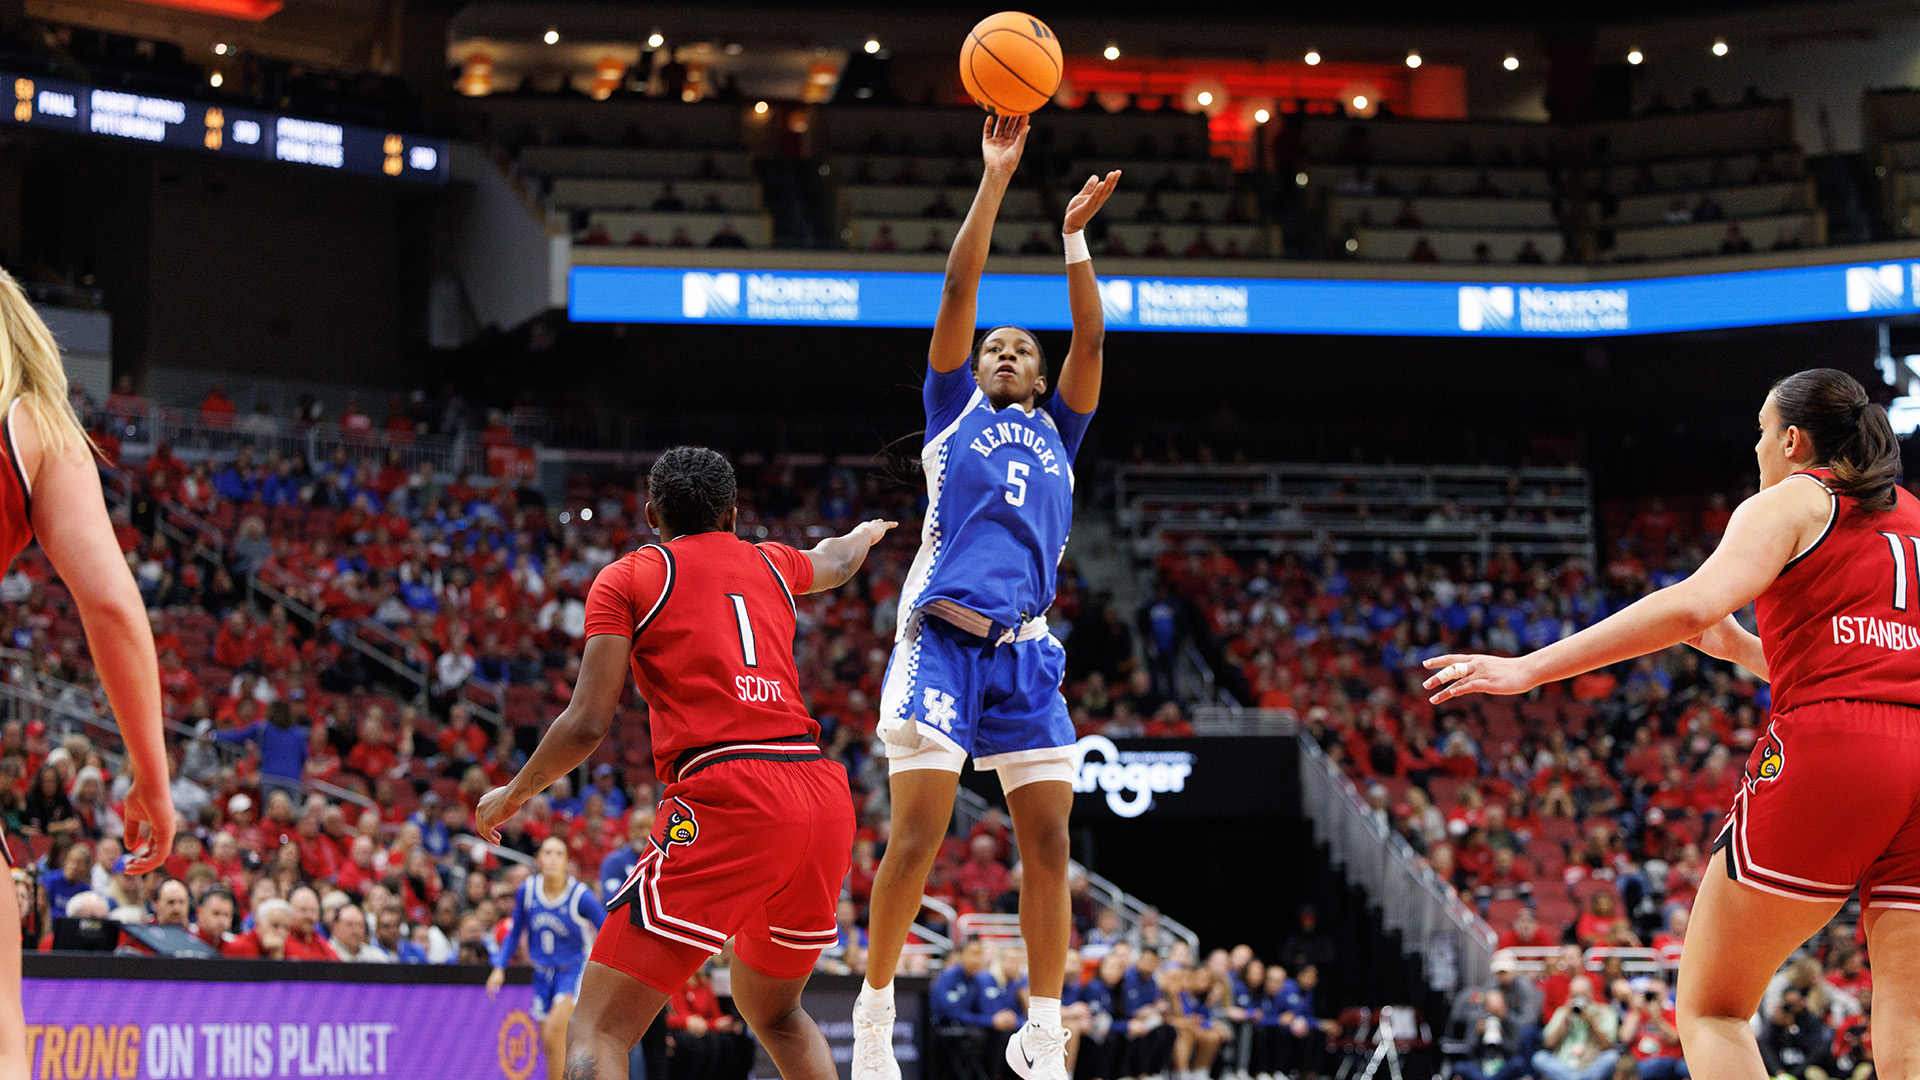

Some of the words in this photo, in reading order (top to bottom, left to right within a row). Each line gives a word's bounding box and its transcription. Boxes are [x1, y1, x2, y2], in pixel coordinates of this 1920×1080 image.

[970, 422, 1060, 477] KENTUCKY
[1005, 460, 1030, 507] 5
[724, 593, 758, 668] 1
[735, 675, 786, 702] SCOTT
[25, 1023, 141, 1080] TRONG
[146, 1023, 194, 1080] ON
[200, 1022, 274, 1079] THIS
[278, 1021, 392, 1077] PLANET
